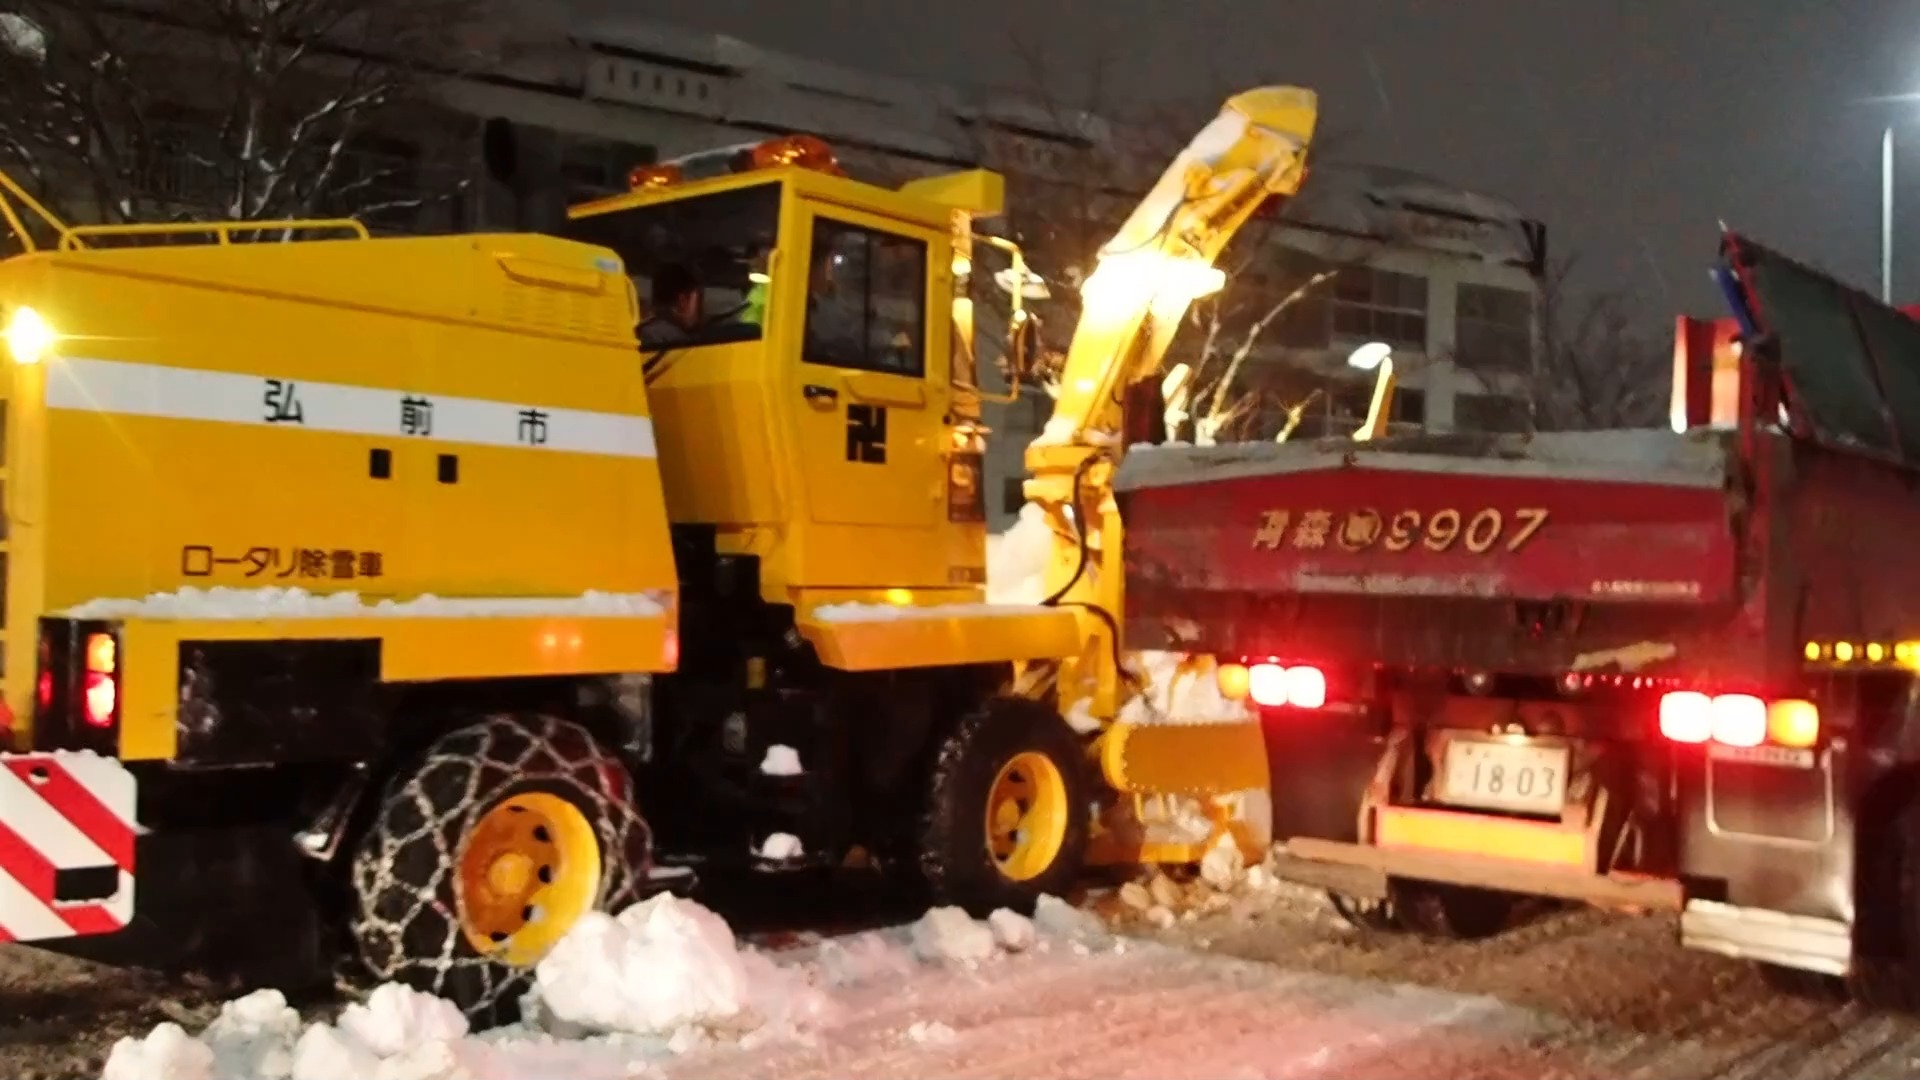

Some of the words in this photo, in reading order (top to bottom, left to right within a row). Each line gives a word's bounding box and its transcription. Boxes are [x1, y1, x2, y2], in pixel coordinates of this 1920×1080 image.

[264, 379, 549, 444] 弘前市
[182, 544, 384, 579] ロータリ除雪車
